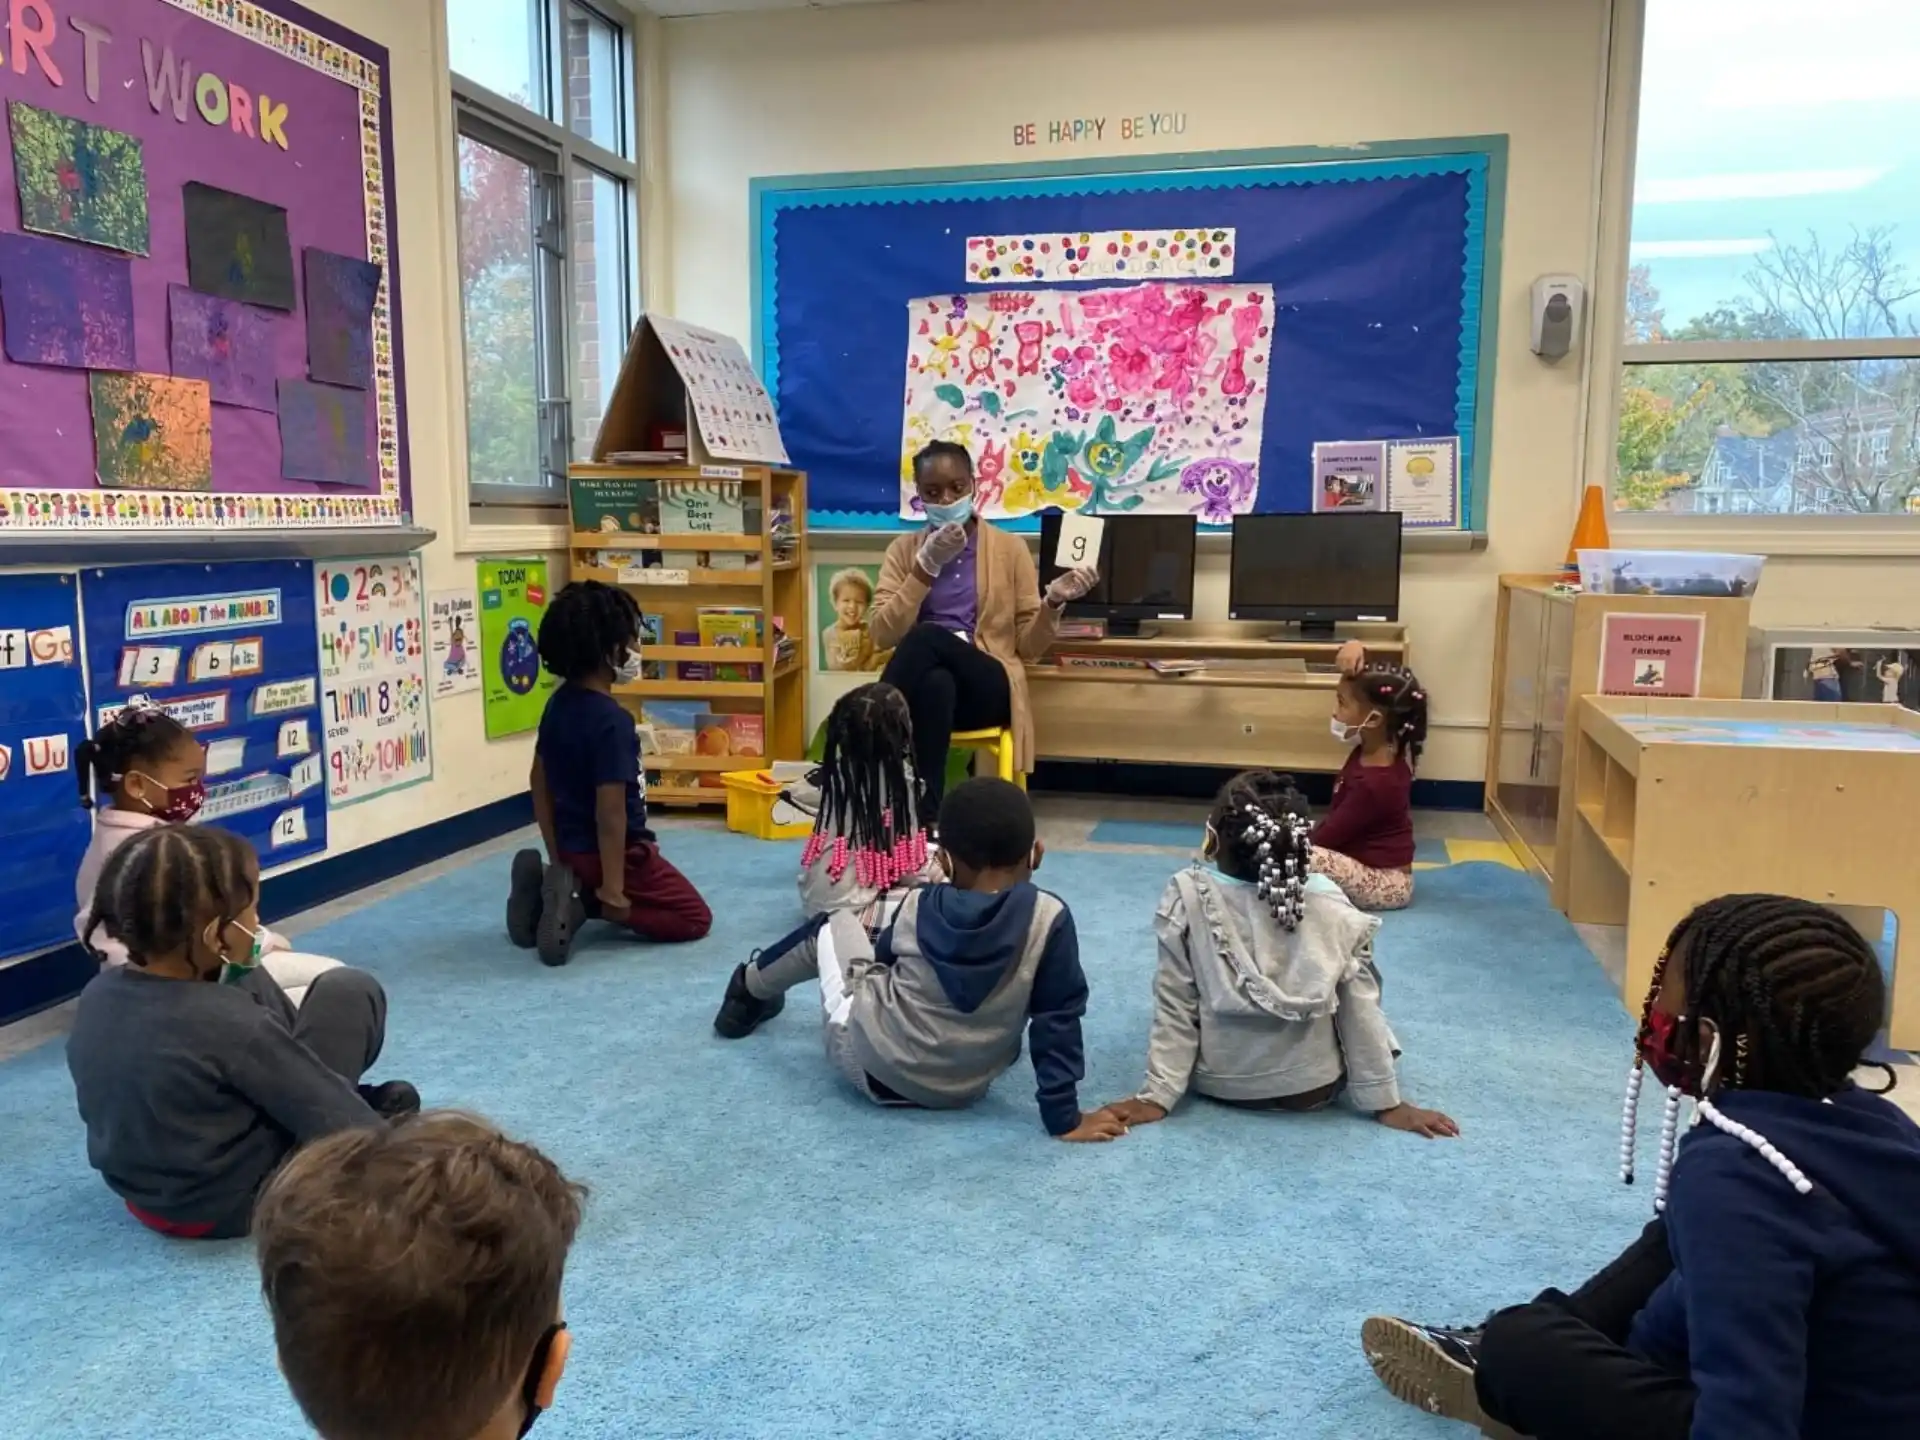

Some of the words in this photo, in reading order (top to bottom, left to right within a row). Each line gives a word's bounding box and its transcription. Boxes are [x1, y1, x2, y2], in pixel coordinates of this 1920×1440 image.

[0, 0, 111, 103] RT
[139, 38, 288, 151] WORK
[1013, 123, 1036, 146] BE
[1049, 117, 1106, 143] HAPPY
[1121, 117, 1144, 140] BE
[1150, 112, 1187, 135] YOU
[685, 498, 709, 509] One
[320, 569, 329, 605] 1
[354, 566, 369, 600] 2
[392, 566, 402, 595] 3
[498, 568, 526, 585] TODAY
[133, 611, 158, 629] ALL
[162, 606, 208, 626] ABOUT
[209, 606, 226, 621] the
[228, 599, 276, 621] NUMBER
[322, 632, 335, 665] 4
[358, 627, 370, 659] 5
[395, 624, 405, 652] 6
[1623, 634, 1654, 642] BLOCK
[1657, 634, 1682, 642] AREA
[0, 633, 14, 665] f
[1631, 647, 1671, 656] FRIENDS
[150, 656, 160, 675] 3
[1071, 659, 1137, 668] OCTOBER
[182, 699, 216, 713] number
[326, 690, 339, 723] 7
[378, 681, 389, 714] 8
[287, 730, 298, 748] 12
[327, 727, 349, 738] SEVEN
[28, 739, 65, 771] Uu
[331, 751, 343, 782] 9
[376, 740, 395, 771] 10
[301, 765, 311, 784] 11
[282, 818, 294, 836] 12
